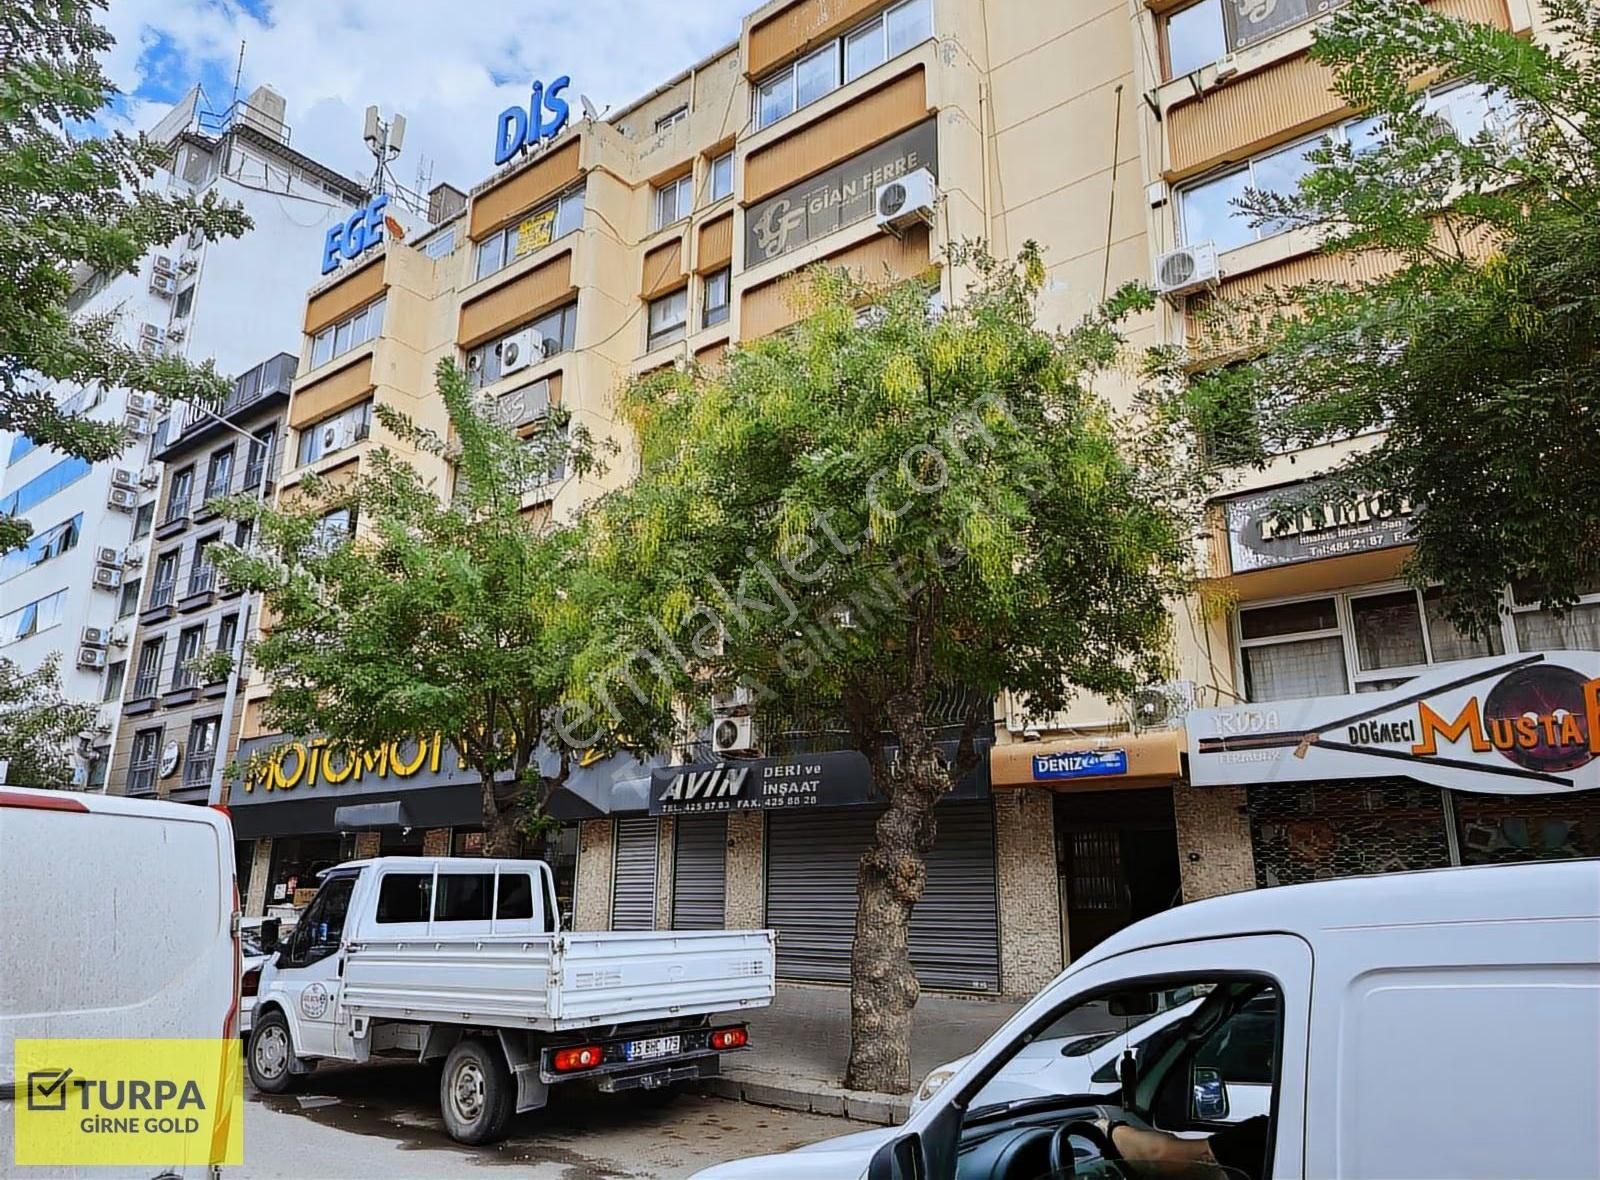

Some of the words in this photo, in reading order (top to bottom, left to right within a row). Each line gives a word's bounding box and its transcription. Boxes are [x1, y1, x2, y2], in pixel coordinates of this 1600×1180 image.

[863, 152, 918, 190] FERRE
[322, 194, 388, 275] EGE
[658, 763, 749, 801] AVİN
[805, 764, 821, 775] ve
[763, 780, 821, 797] İNŞAAT
[737, 800, 761, 808] FAX.
[764, 798, 784, 807] 425
